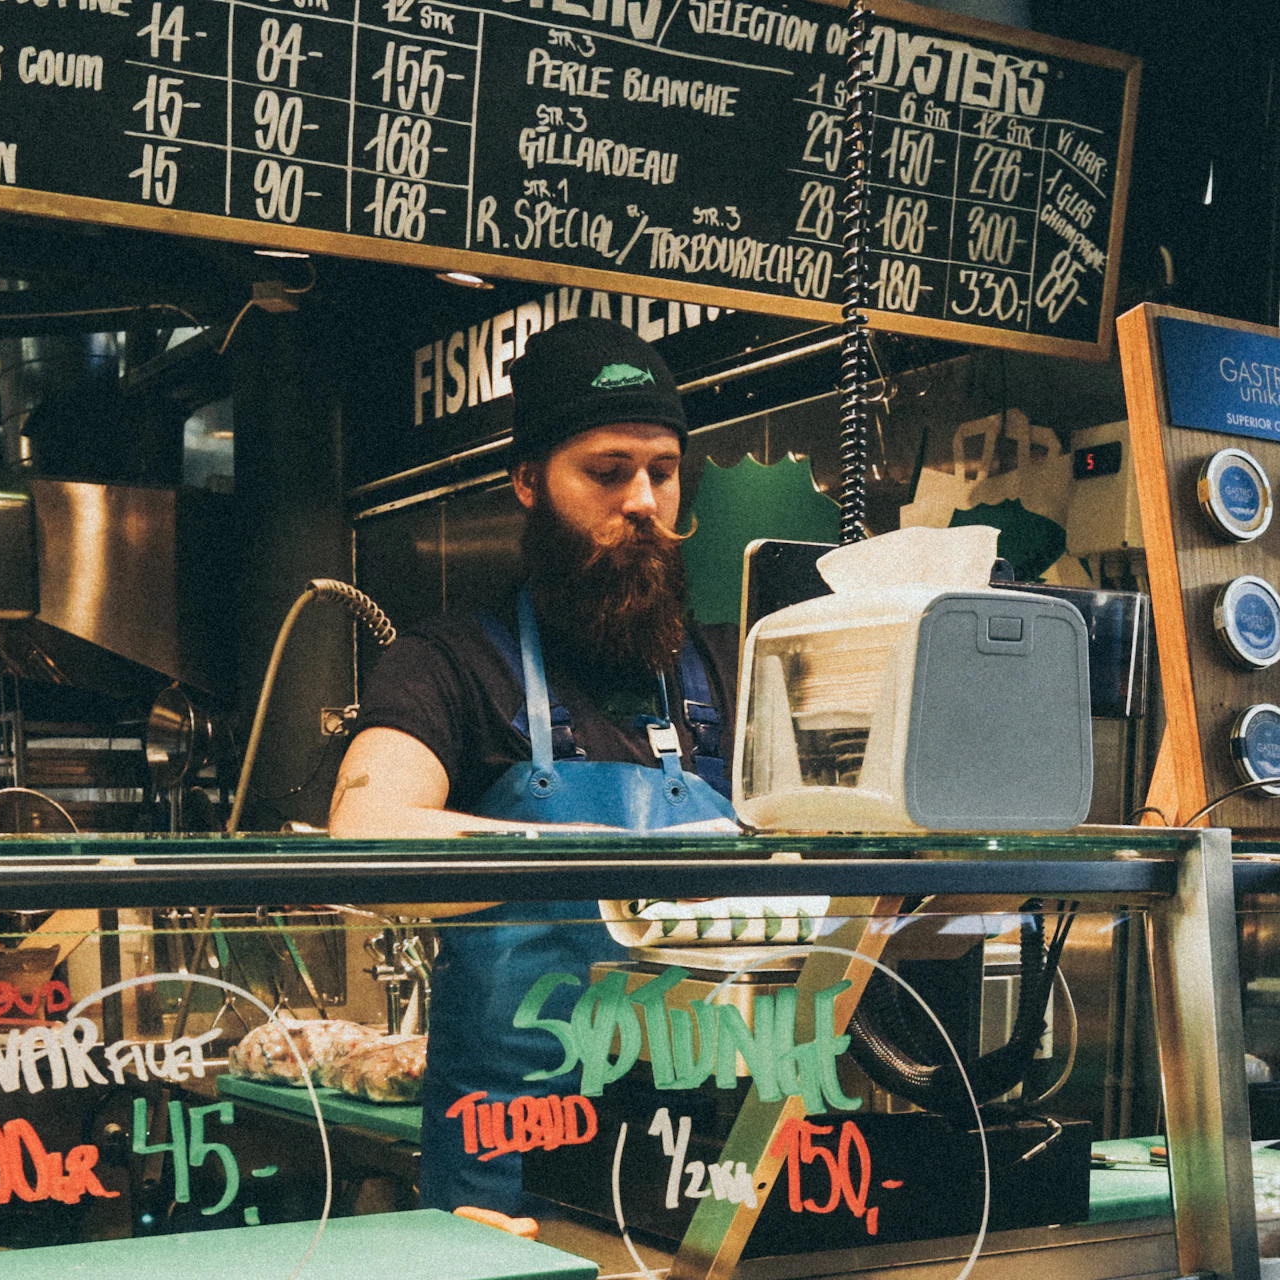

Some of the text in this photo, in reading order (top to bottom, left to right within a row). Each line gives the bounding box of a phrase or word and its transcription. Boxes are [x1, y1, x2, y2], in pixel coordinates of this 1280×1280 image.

[526, 47, 614, 99] PERLE
[859, 25, 1049, 117] OYSTERS
[899, 91, 916, 124] 6
[518, 126, 679, 186] GILLARDEAU
[1226, 411, 1273, 431] SUPERIOR
[445, 1090, 599, 1163] TILBUD
